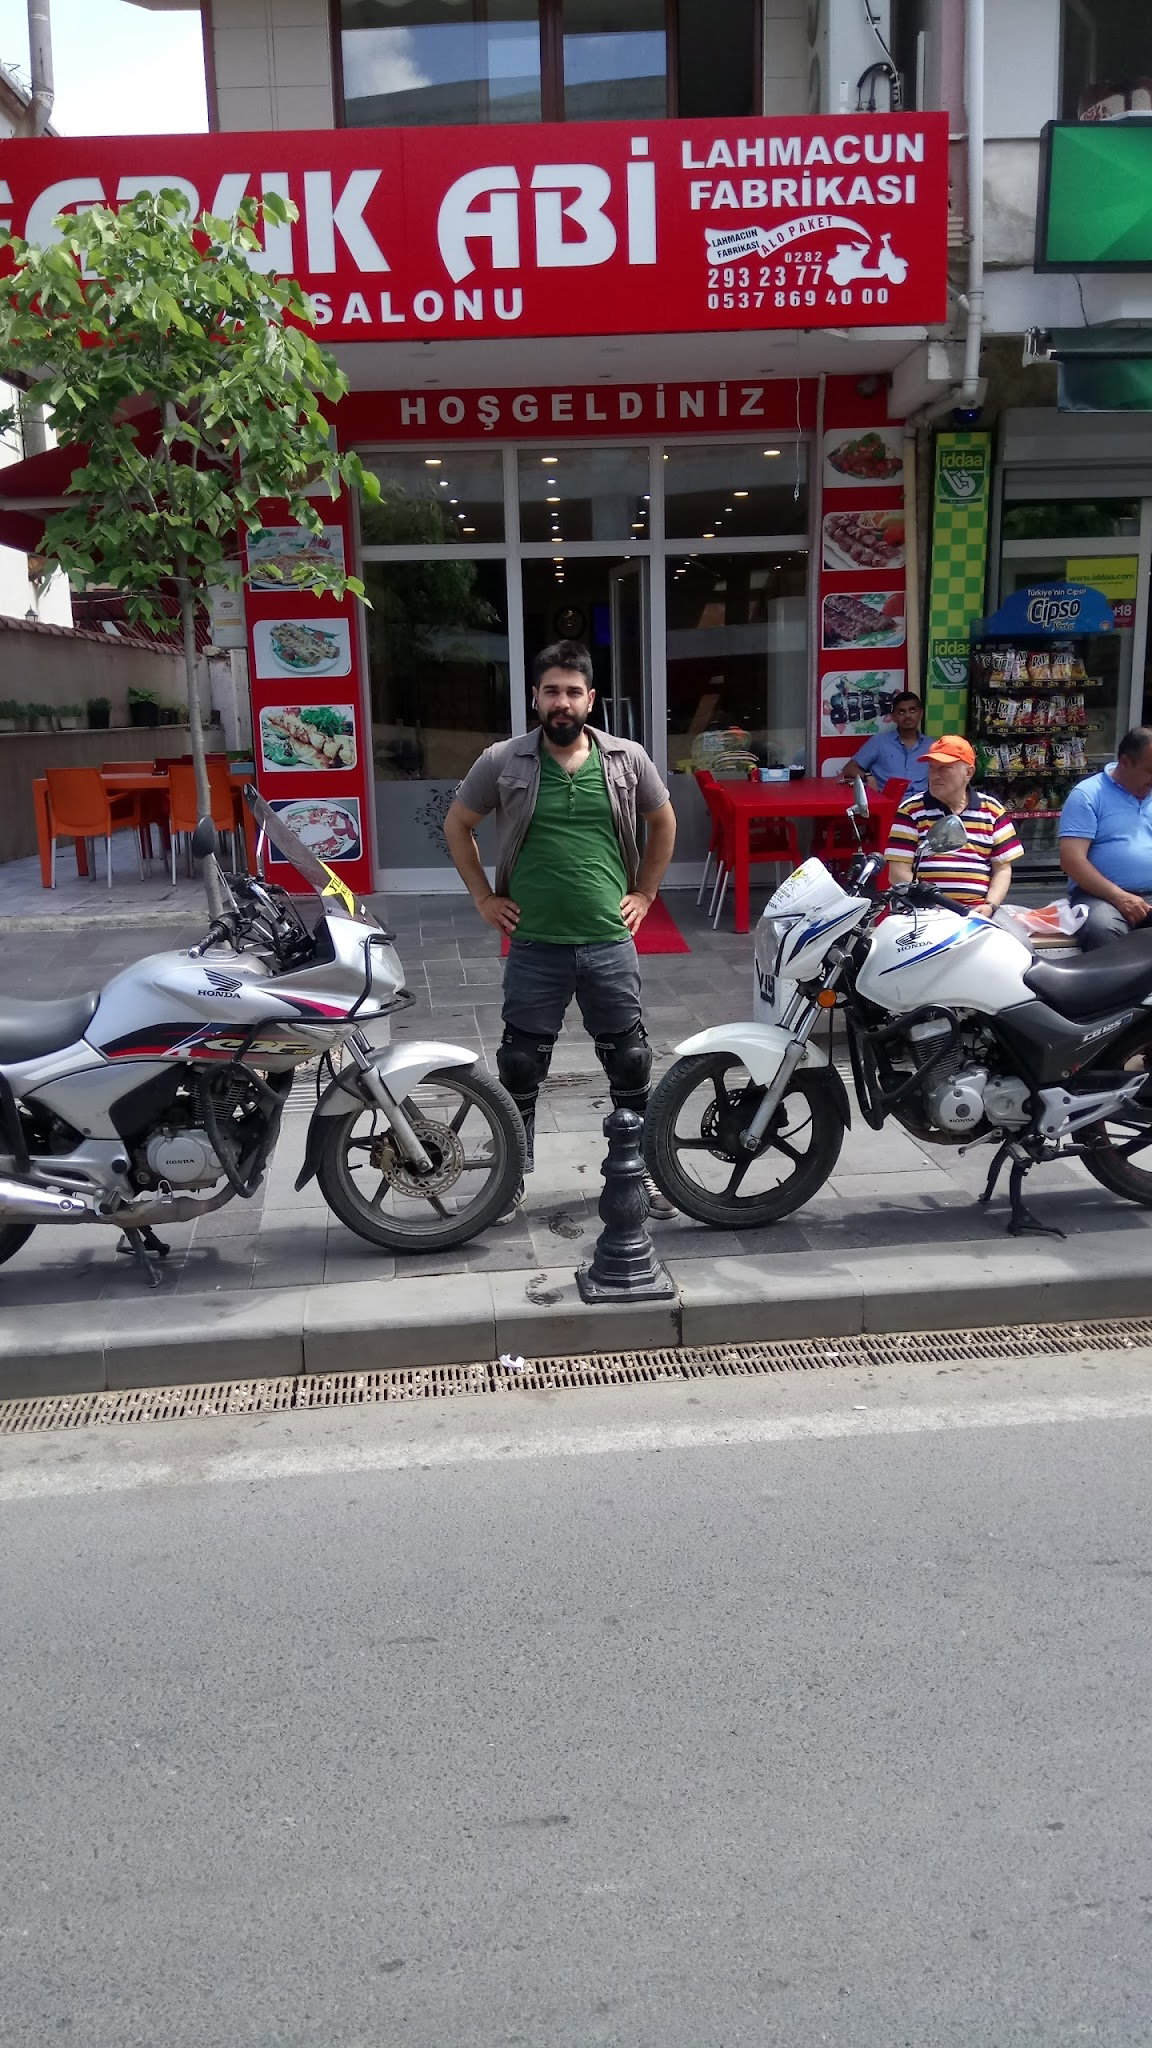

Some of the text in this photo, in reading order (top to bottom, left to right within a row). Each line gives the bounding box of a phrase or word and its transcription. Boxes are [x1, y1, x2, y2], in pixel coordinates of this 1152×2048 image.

[682, 133, 924, 169] LAHMACUN
[690, 170, 916, 210] FABRİKASI
[437, 136, 658, 285] ABİ
[711, 229, 758, 247] LAHMACUN
[761, 216, 832, 255] ALO PAKET
[717, 241, 760, 258] FABRİKASI
[785, 251, 822, 263] 0282
[708, 265, 822, 288] 293 23 77
[310, 288, 523, 325] SALONU
[708, 287, 888, 310] 0537 869 40 00
[401, 382, 764, 431] HOŞGELDİNİZ
[942, 452, 983, 467] iddaa
[1027, 588, 1065, 597] Türkiye'nin
[1027, 597, 1081, 628] Cipso
[1112, 604, 1132, 617] +18
[897, 941, 933, 953] HONDA
[197, 989, 242, 999] HONDA
